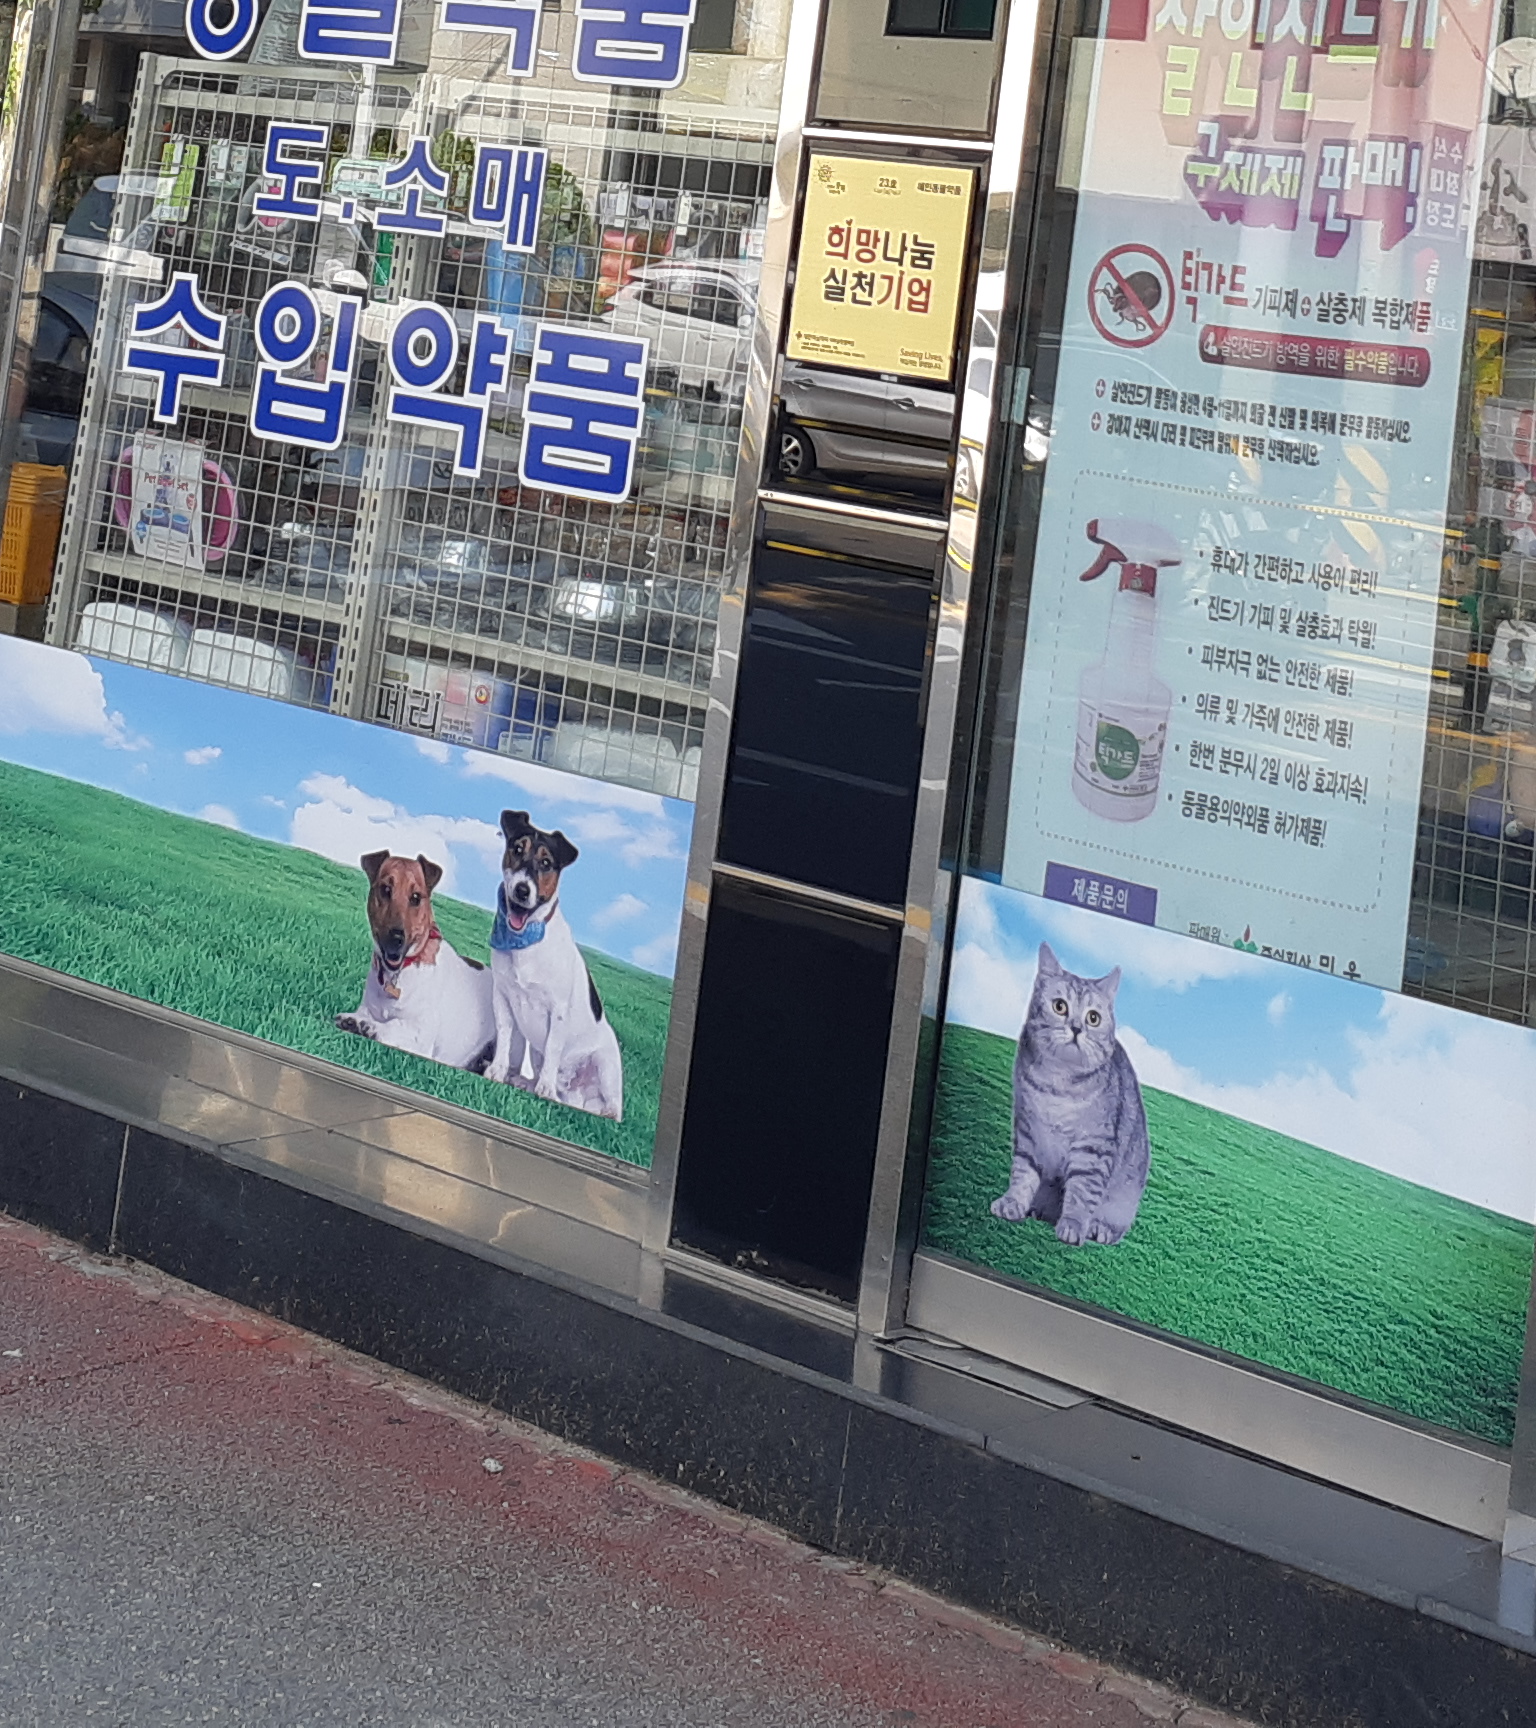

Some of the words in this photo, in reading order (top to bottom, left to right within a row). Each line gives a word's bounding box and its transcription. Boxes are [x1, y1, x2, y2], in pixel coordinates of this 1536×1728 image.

[253, 120, 548, 254] 도.소매
[1186, 121, 1302, 200] 구제제
[1318, 141, 1420, 233] 판매!
[825, 222, 935, 270] 희망나눔
[823, 269, 932, 313] 실천기업
[1181, 250, 1248, 323] 틱가드
[1252, 286, 1298, 319] 기피제
[1315, 291, 1366, 327] 살충제
[1371, 296, 1432, 333] 복합제품
[1220, 335, 1273, 363] 살인진드기
[1276, 342, 1311, 368] 방역을
[1315, 345, 1341, 370] 위한
[123, 273, 655, 503] 수입약품
[1111, 380, 1152, 407] 살인진드기
[1211, 546, 1249, 577] 휴대가
[1254, 553, 1304, 585] 간편하고
[1308, 562, 1344, 592] 사용이
[1349, 569, 1378, 599] 편리!
[1207, 595, 1245, 626] 진드기
[1249, 603, 1274, 631] 기피
[1279, 607, 1291, 634] 및
[1296, 610, 1343, 643] 살충효과
[1348, 619, 1377, 650] 탁월!
[1201, 644, 1252, 678] 피부자극
[1256, 653, 1281, 683] 없는
[1285, 659, 1321, 690] 안전한
[1324, 668, 1354, 697] 제품!
[1195, 693, 1221, 722] 의류
[1226, 698, 1239, 726] 및
[1241, 702, 1280, 734] 가죽에
[1283, 709, 1320, 742] 안전한
[1323, 718, 1354, 749] 제품!
[1189, 740, 1215, 771] 한번
[1219, 746, 1258, 781] 분무시
[1259, 756, 1281, 786] 2일
[1284, 761, 1310, 792] 이상
[1313, 767, 1369, 805] 효과지속!
[1181, 789, 1270, 835] 동물용의약외품
[1273, 810, 1328, 849] 허가제품!
[1070, 877, 1129, 914] 제품문의
